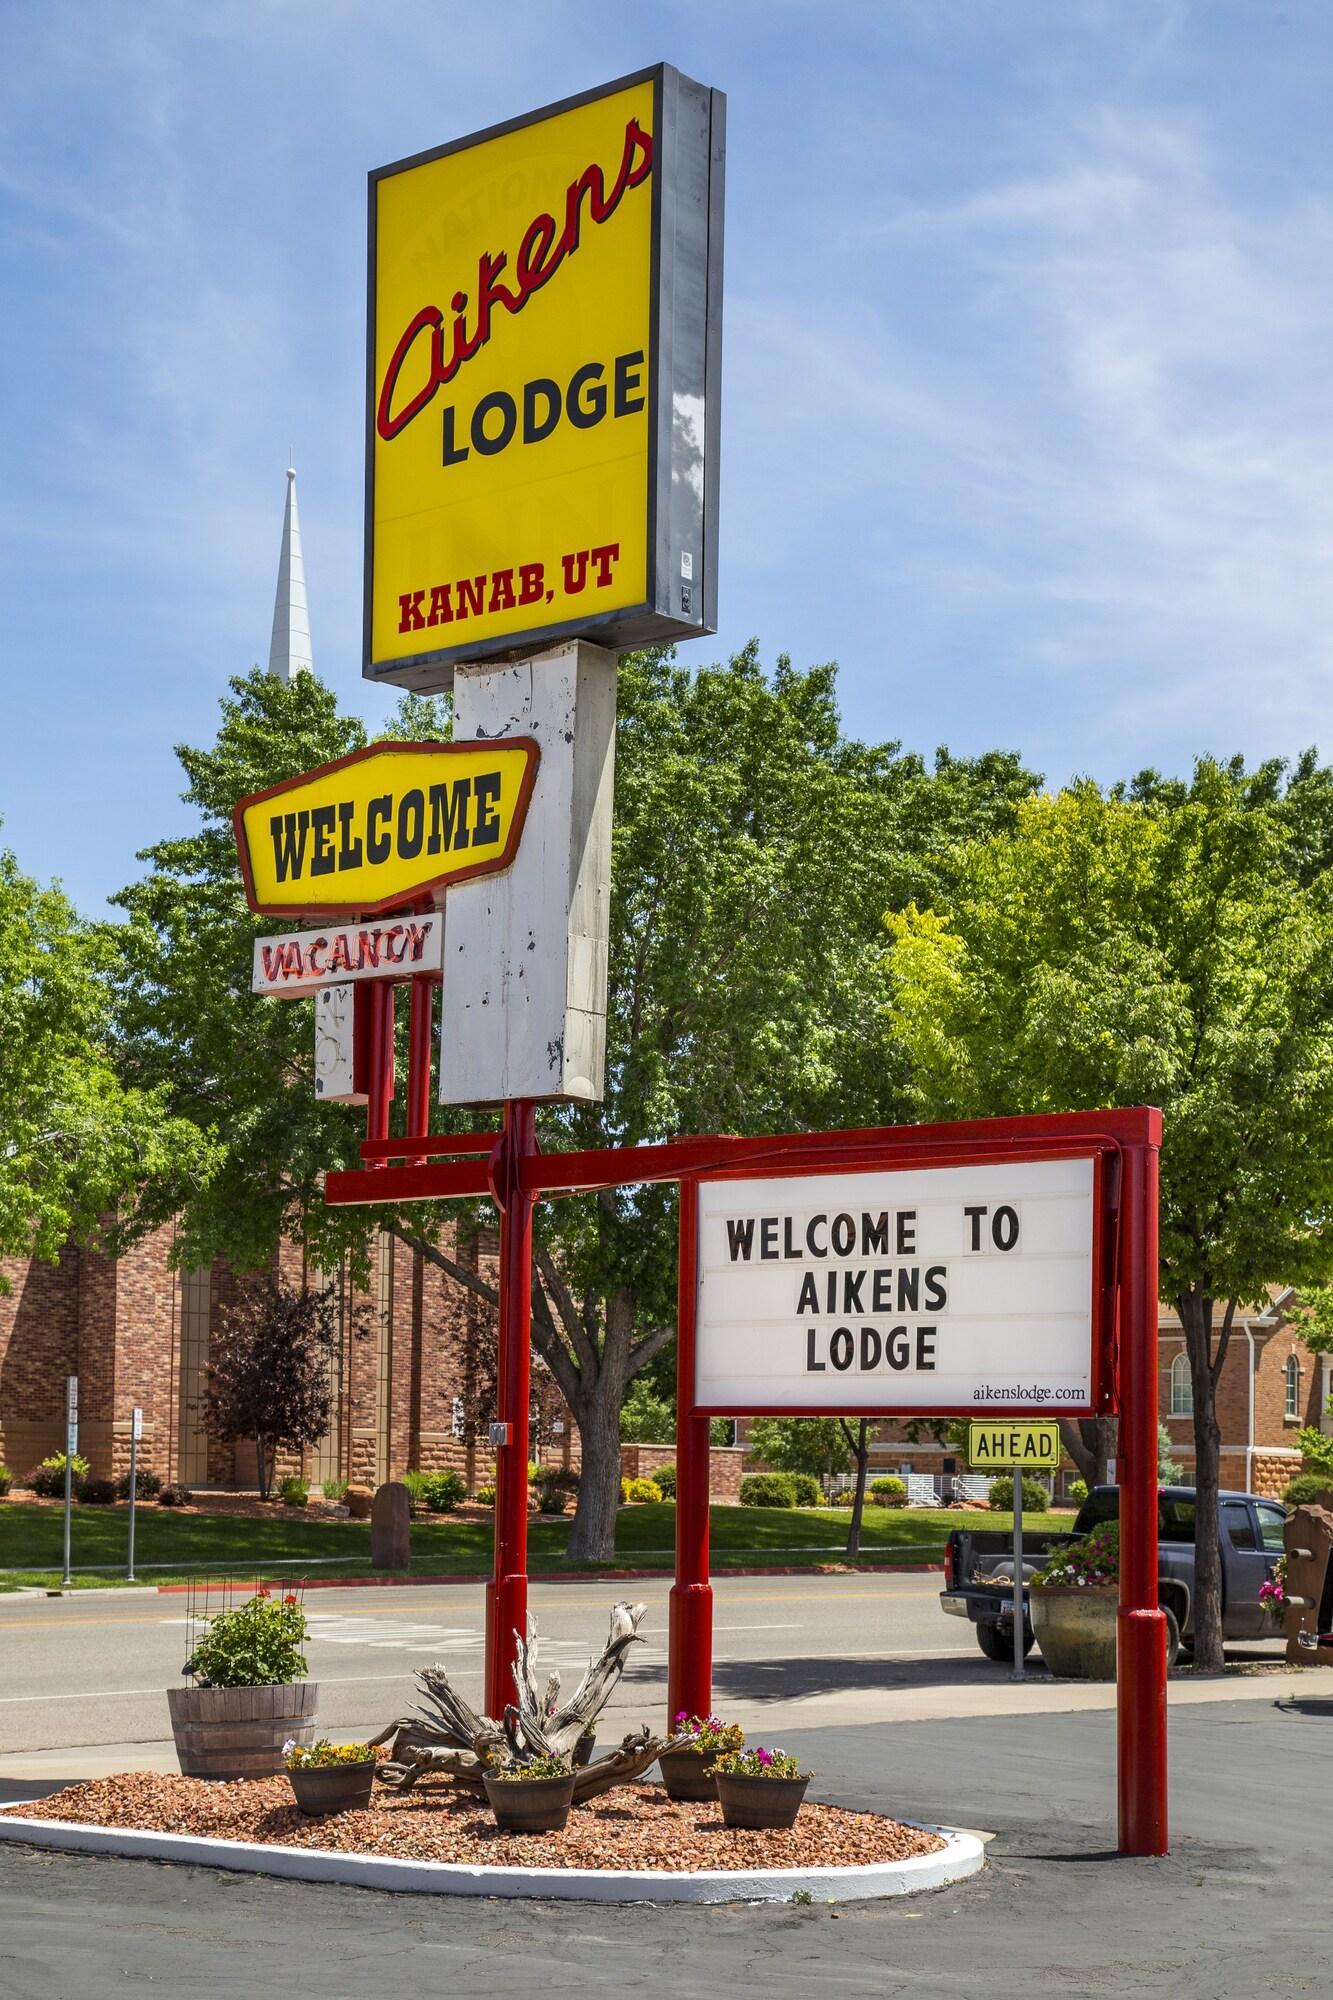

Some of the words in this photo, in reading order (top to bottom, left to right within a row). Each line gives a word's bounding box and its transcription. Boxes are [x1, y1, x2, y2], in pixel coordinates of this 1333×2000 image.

[377, 116, 653, 441] Aikens
[442, 350, 645, 467] LODGE
[398, 562, 554, 634] KANAB,
[561, 543, 620, 594] UT
[270, 771, 501, 883] WELCOME
[260, 921, 433, 982] VACANCY
[726, 1211, 917, 1261] WELCOME
[963, 1205, 1020, 1252] TO
[796, 1266, 947, 1314] AIKENS
[806, 1326, 937, 1371] LODGE
[973, 1384, 1086, 1402] aikenslodge.com
[976, 1433, 1053, 1457] AHEAD
